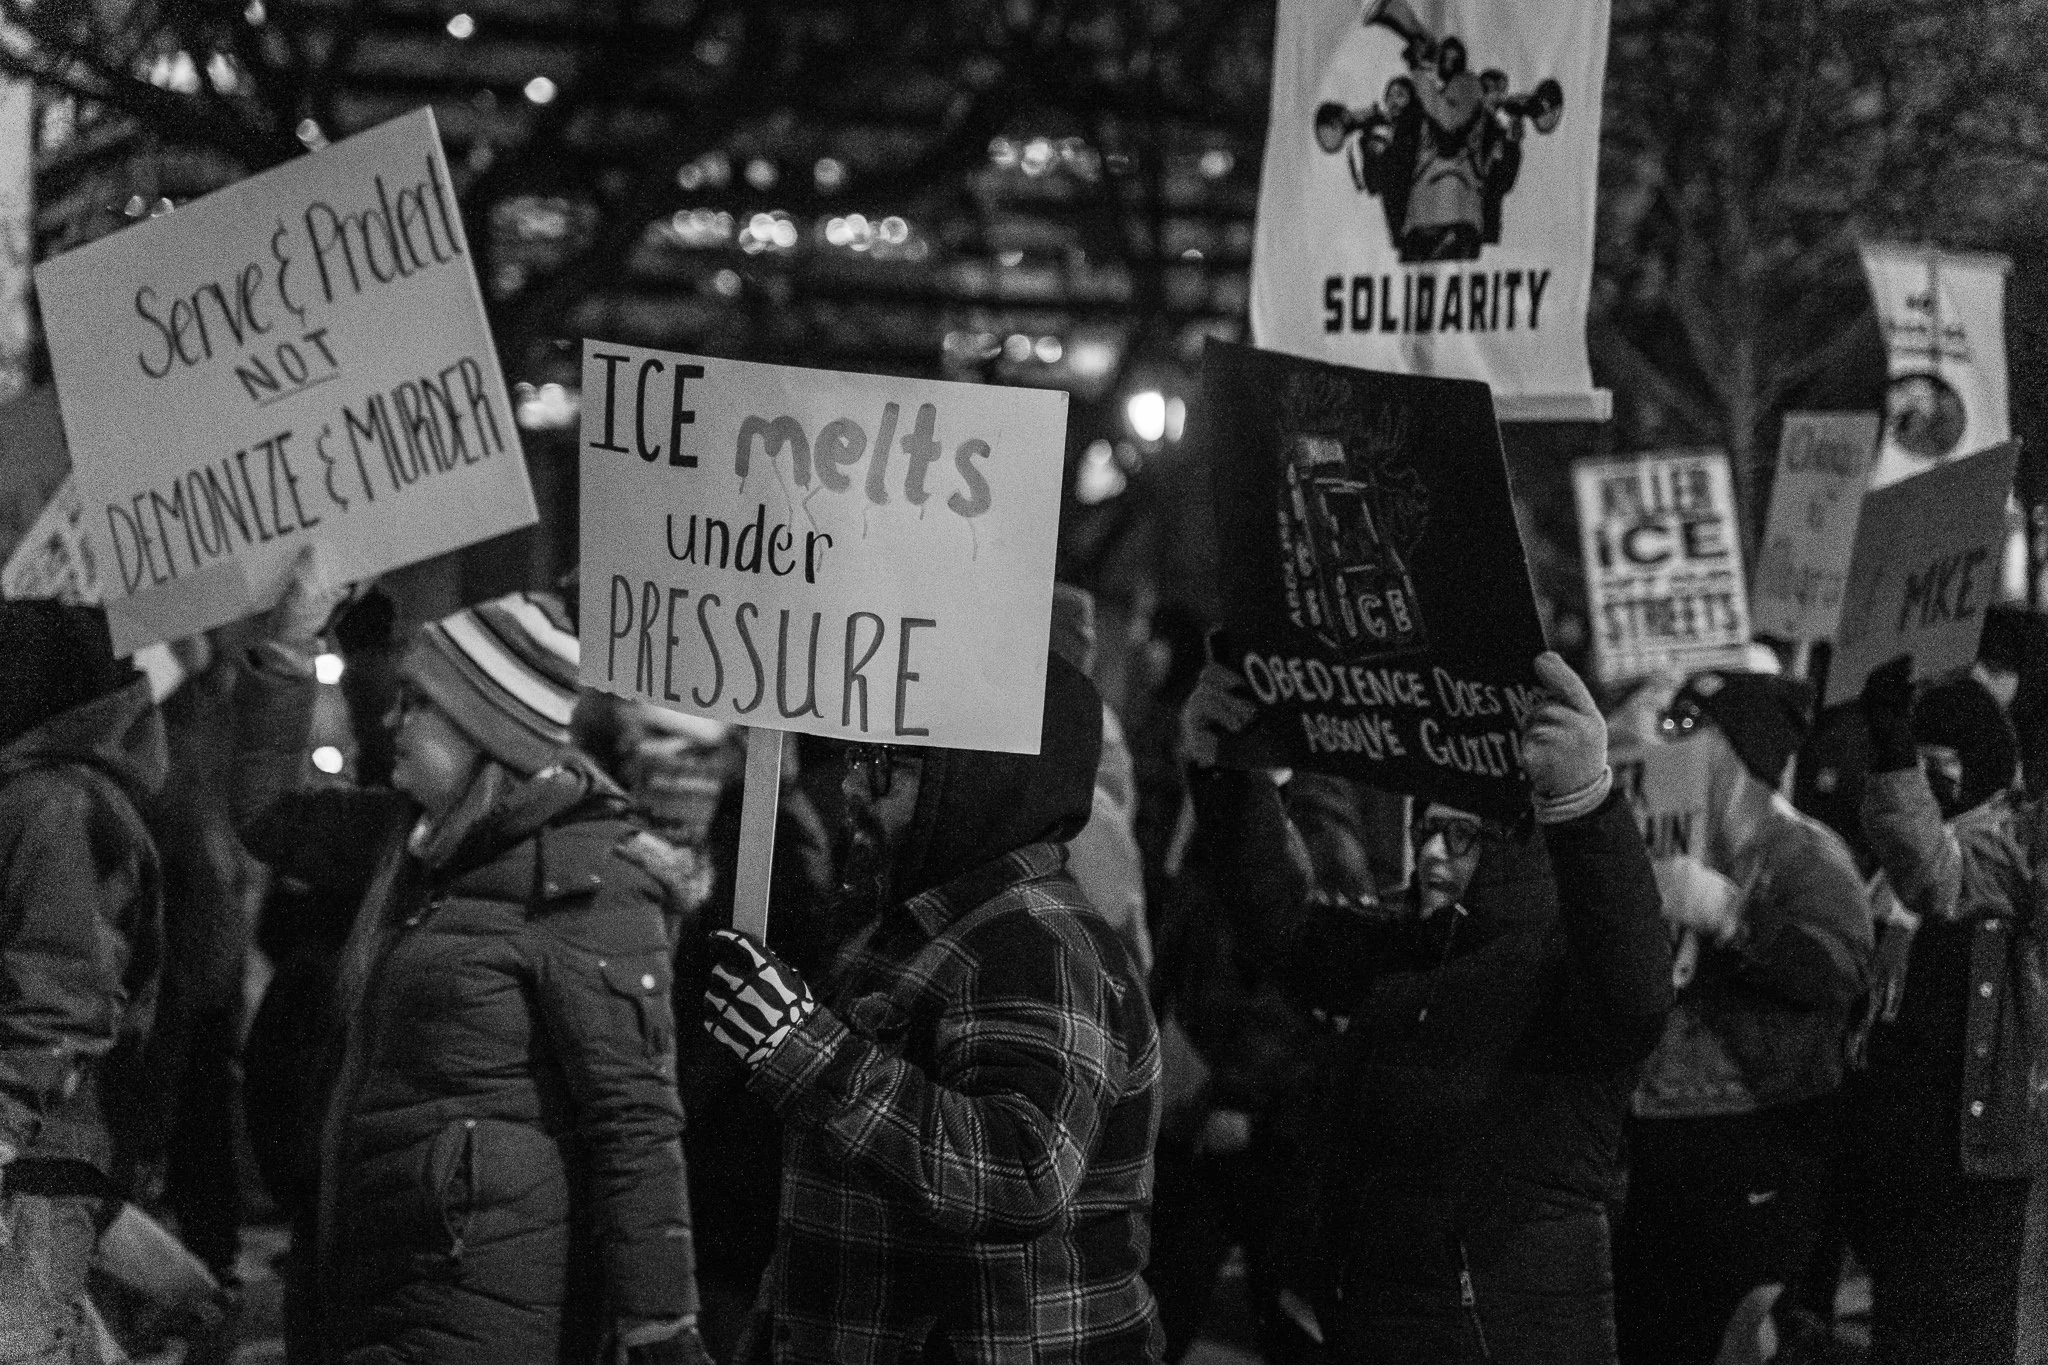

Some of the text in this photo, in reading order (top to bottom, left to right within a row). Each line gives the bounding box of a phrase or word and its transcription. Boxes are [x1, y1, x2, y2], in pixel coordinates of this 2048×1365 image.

[134, 154, 463, 379] Serve & Protect
[1324, 268, 1552, 334] SOLIDARITY
[235, 327, 340, 402] NOT
[107, 430, 321, 595] DEMONIZE
[315, 424, 350, 514] &
[343, 356, 506, 502] MURDER
[589, 352, 993, 520] ICE melts
[665, 503, 833, 585] under
[1595, 513, 1729, 568] ICE
[606, 573, 938, 738] PRESSURE
[1244, 651, 1431, 706] OBEDIENCE
[1432, 666, 1502, 718] DOES
